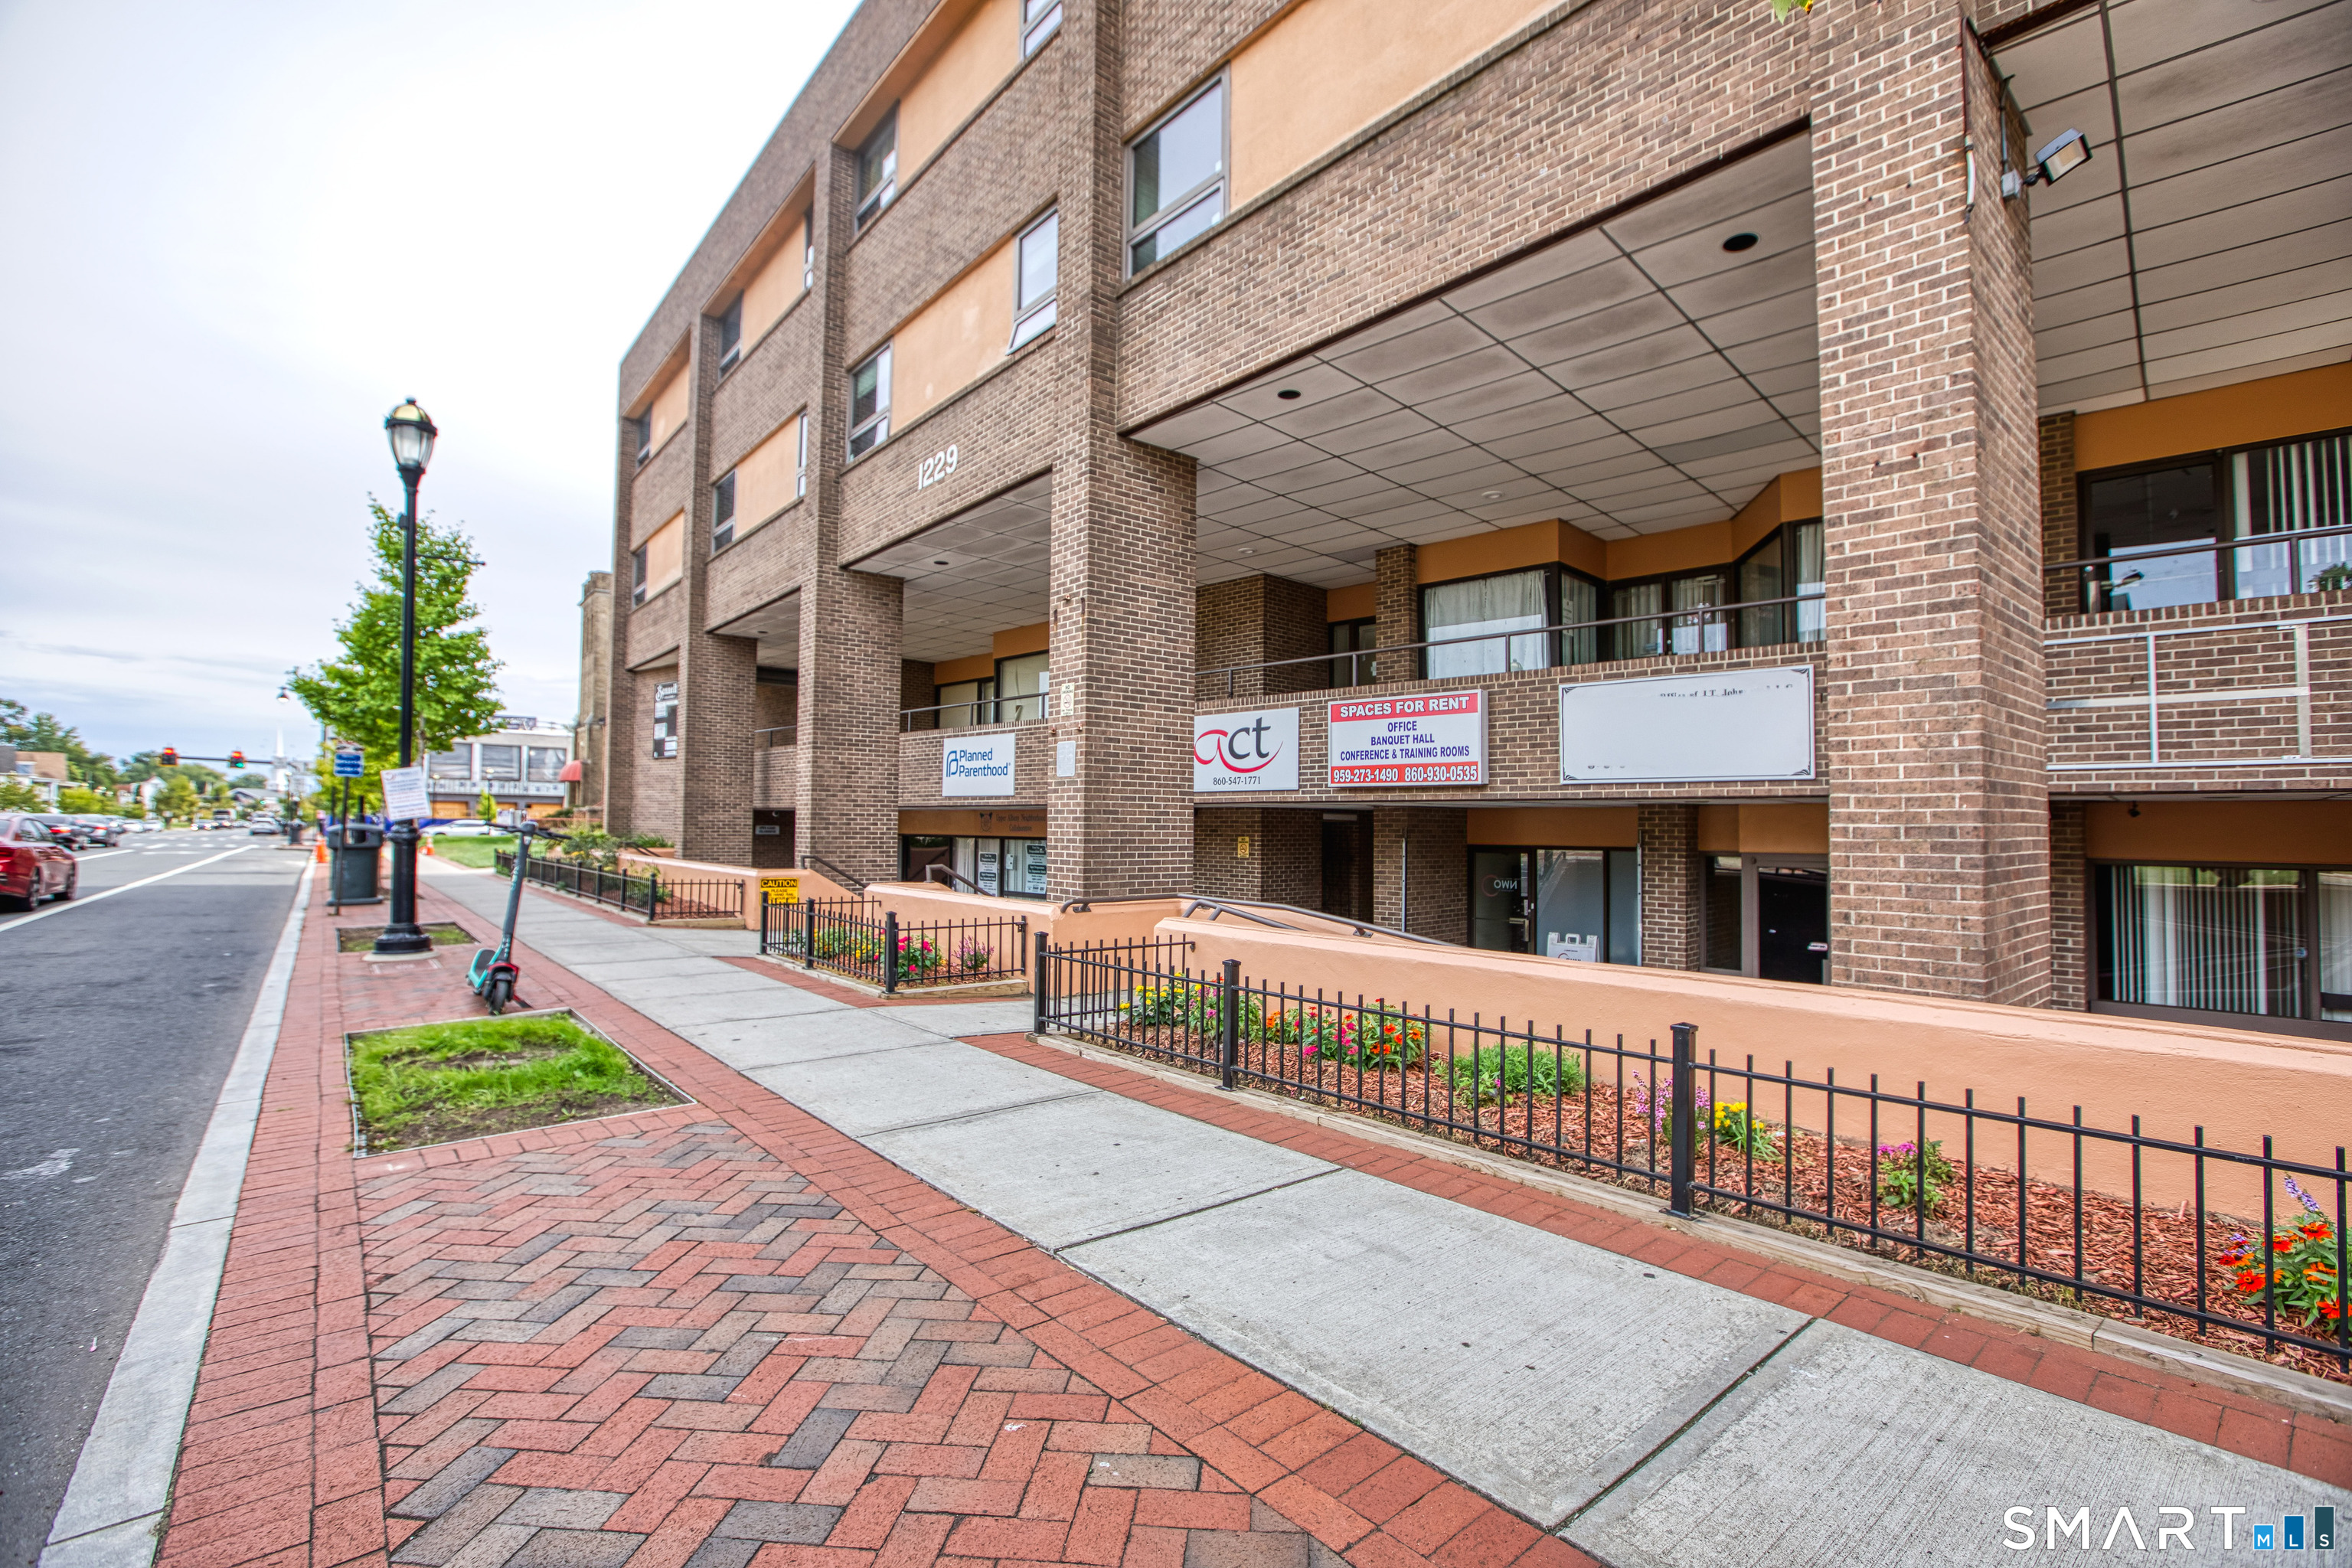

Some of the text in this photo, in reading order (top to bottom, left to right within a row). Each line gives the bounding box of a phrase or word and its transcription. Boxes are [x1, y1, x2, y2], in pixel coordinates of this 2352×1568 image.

[918, 444, 959, 490] 1229
[1340, 696, 1469, 718] SPACES FOR RENT
[1387, 720, 1417, 733] OFFICE
[1194, 717, 1283, 773] act
[1371, 733, 1435, 746] BANQUET HALL
[959, 747, 993, 762] Planned
[1341, 745, 1469, 761] CONFERENCE & TRAINING ROOMS
[959, 762, 1008, 777] Parenthood
[1334, 766, 1478, 782] 959-273-1490 860-930-0535
[1213, 776, 1261, 786] 860-547-1771
